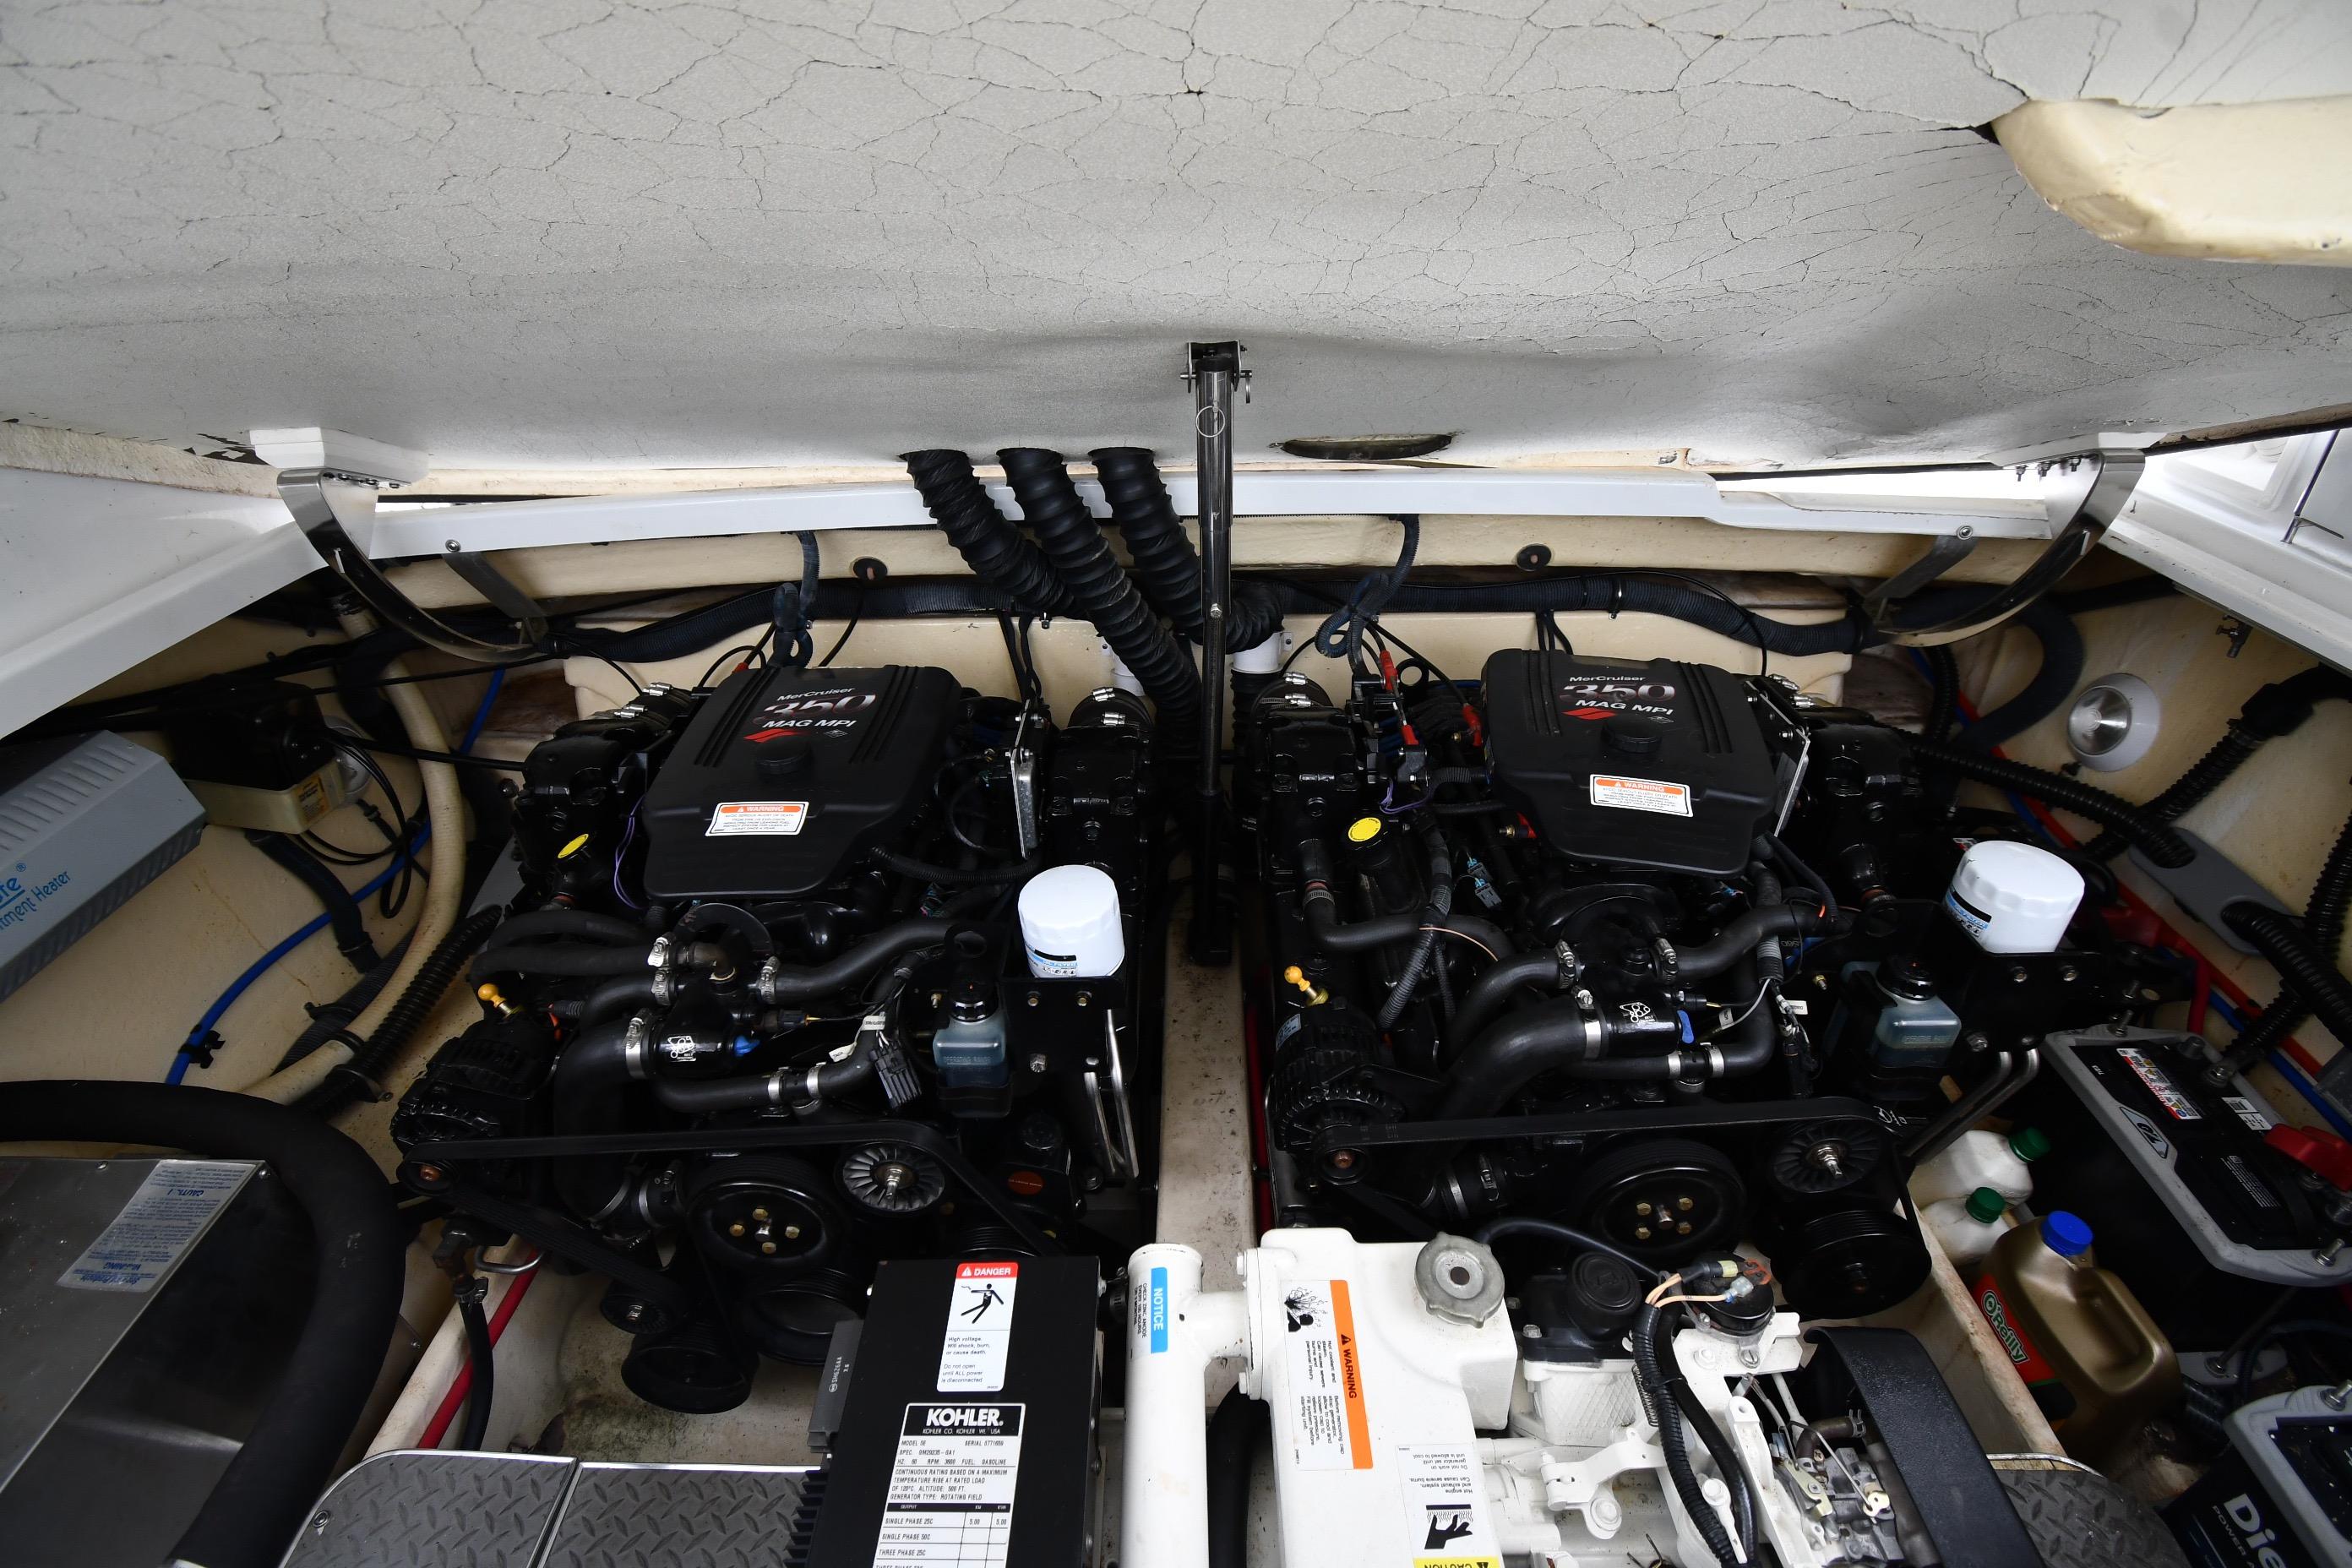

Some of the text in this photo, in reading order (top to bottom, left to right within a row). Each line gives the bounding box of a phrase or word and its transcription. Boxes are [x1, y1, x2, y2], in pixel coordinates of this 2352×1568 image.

[776, 688, 855, 701] MerCruiser
[1560, 683, 1674, 702] 350
[755, 693, 876, 721] 350
[1575, 700, 1674, 715] MAG MPI
[762, 719, 857, 728] MAG MPI
[1624, 781, 1665, 792] WARNING
[30, 871, 71, 902] Heater
[973, 1267, 1012, 1277] DANGER
[1153, 1288, 1163, 1331] NOTICE
[1982, 1290, 2029, 1364] O'Reilly
[1343, 1348, 1357, 1398] WARNING
[2212, 1505, 2247, 1556] POWER
